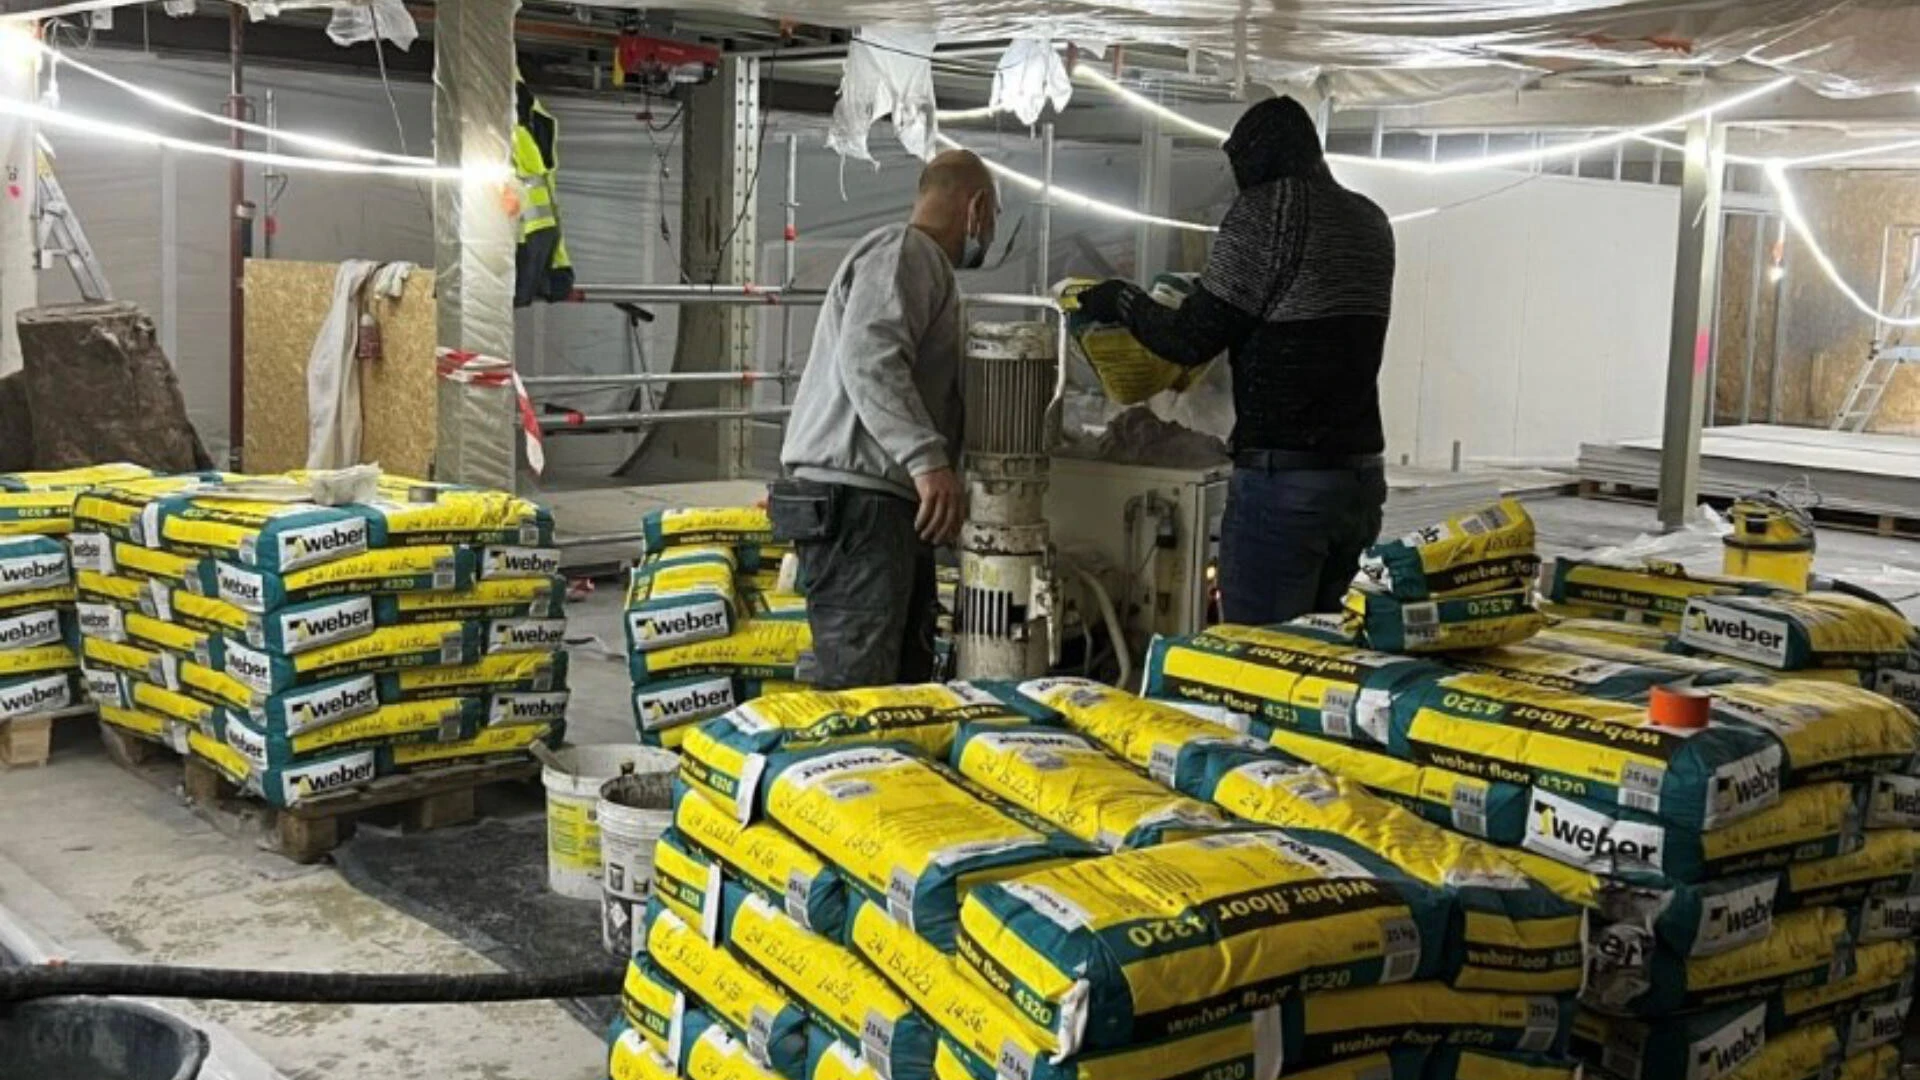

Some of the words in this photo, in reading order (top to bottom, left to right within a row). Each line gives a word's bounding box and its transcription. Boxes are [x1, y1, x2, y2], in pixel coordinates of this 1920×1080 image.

[303, 528, 366, 552] weber
[2, 560, 65, 581] weber
[506, 554, 558, 572] weber
[1467, 600, 1513, 616] 4320
[306, 609, 370, 636] weber
[511, 624, 564, 644] weber
[653, 612, 723, 635] weber
[1704, 616, 1783, 648] weber
[2, 683, 65, 711] weber
[311, 686, 373, 718] weber
[513, 698, 565, 717] weber
[659, 687, 730, 715] weber
[1442, 691, 1504, 714] 4320
[309, 765, 372, 791] weber
[1431, 752, 1486, 776] weber
[1489, 761, 1532, 784] floor
[1538, 775, 1587, 796] 4320
[1551, 815, 1658, 862] weber
[1015, 987, 1053, 1026] 4320
